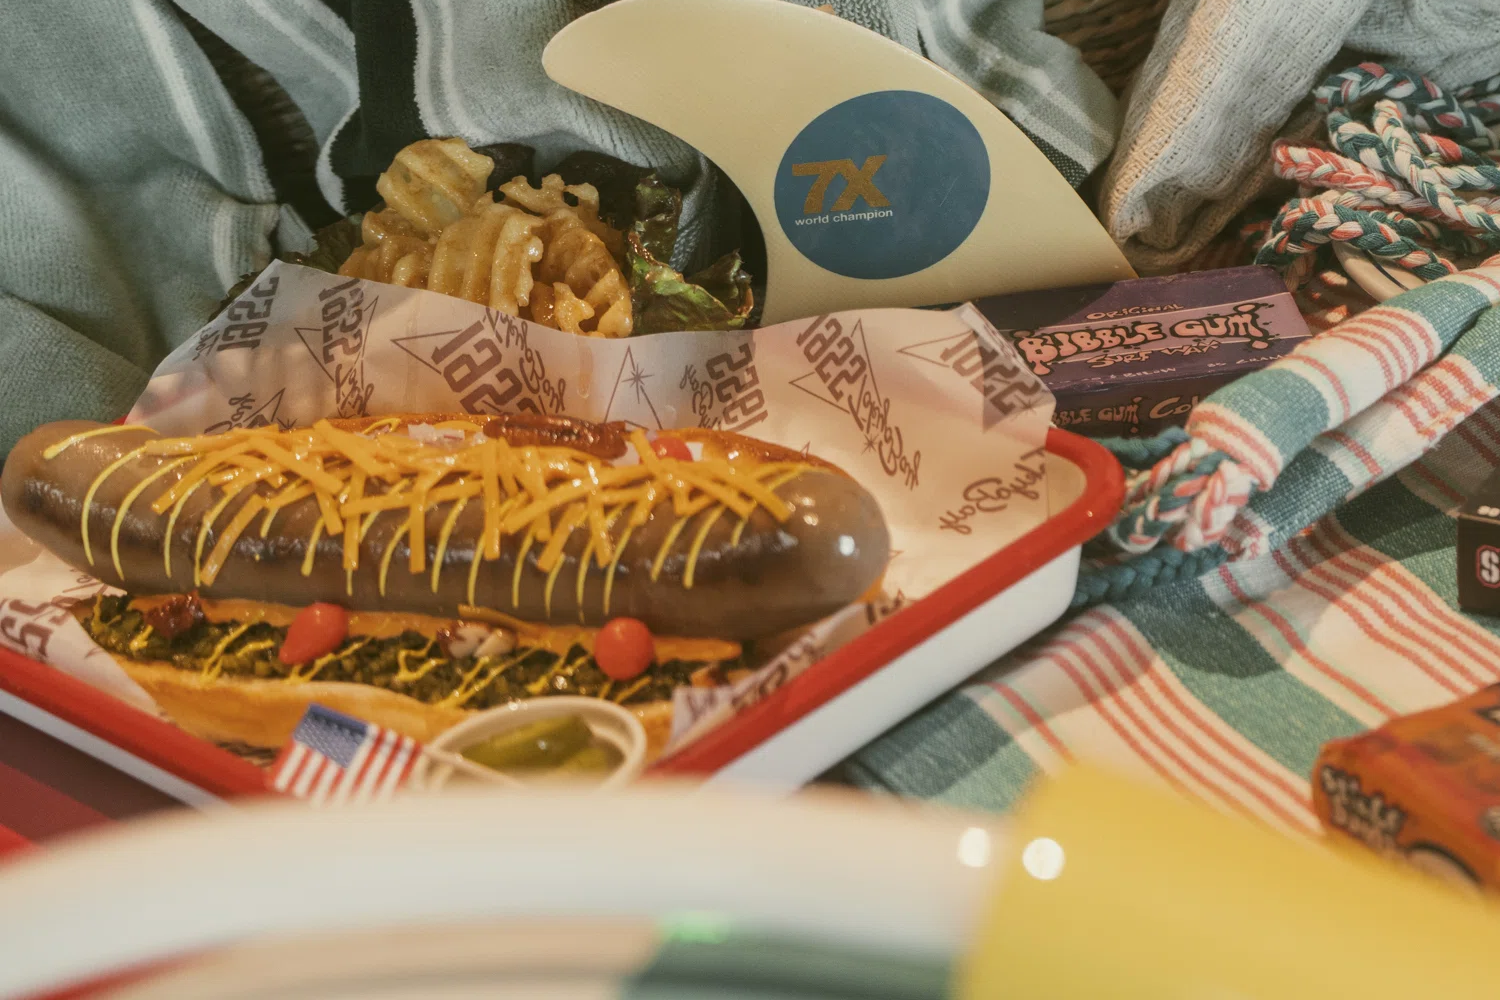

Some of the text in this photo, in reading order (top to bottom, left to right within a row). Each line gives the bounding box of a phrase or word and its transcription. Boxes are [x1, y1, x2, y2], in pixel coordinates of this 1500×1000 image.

[791, 155, 892, 215] 7X
[794, 209, 894, 226] world champion
[1086, 303, 1186, 320] ORIGINAL
[1015, 322, 1166, 376] BUBBLE
[1087, 340, 1221, 368] SURF WAX
